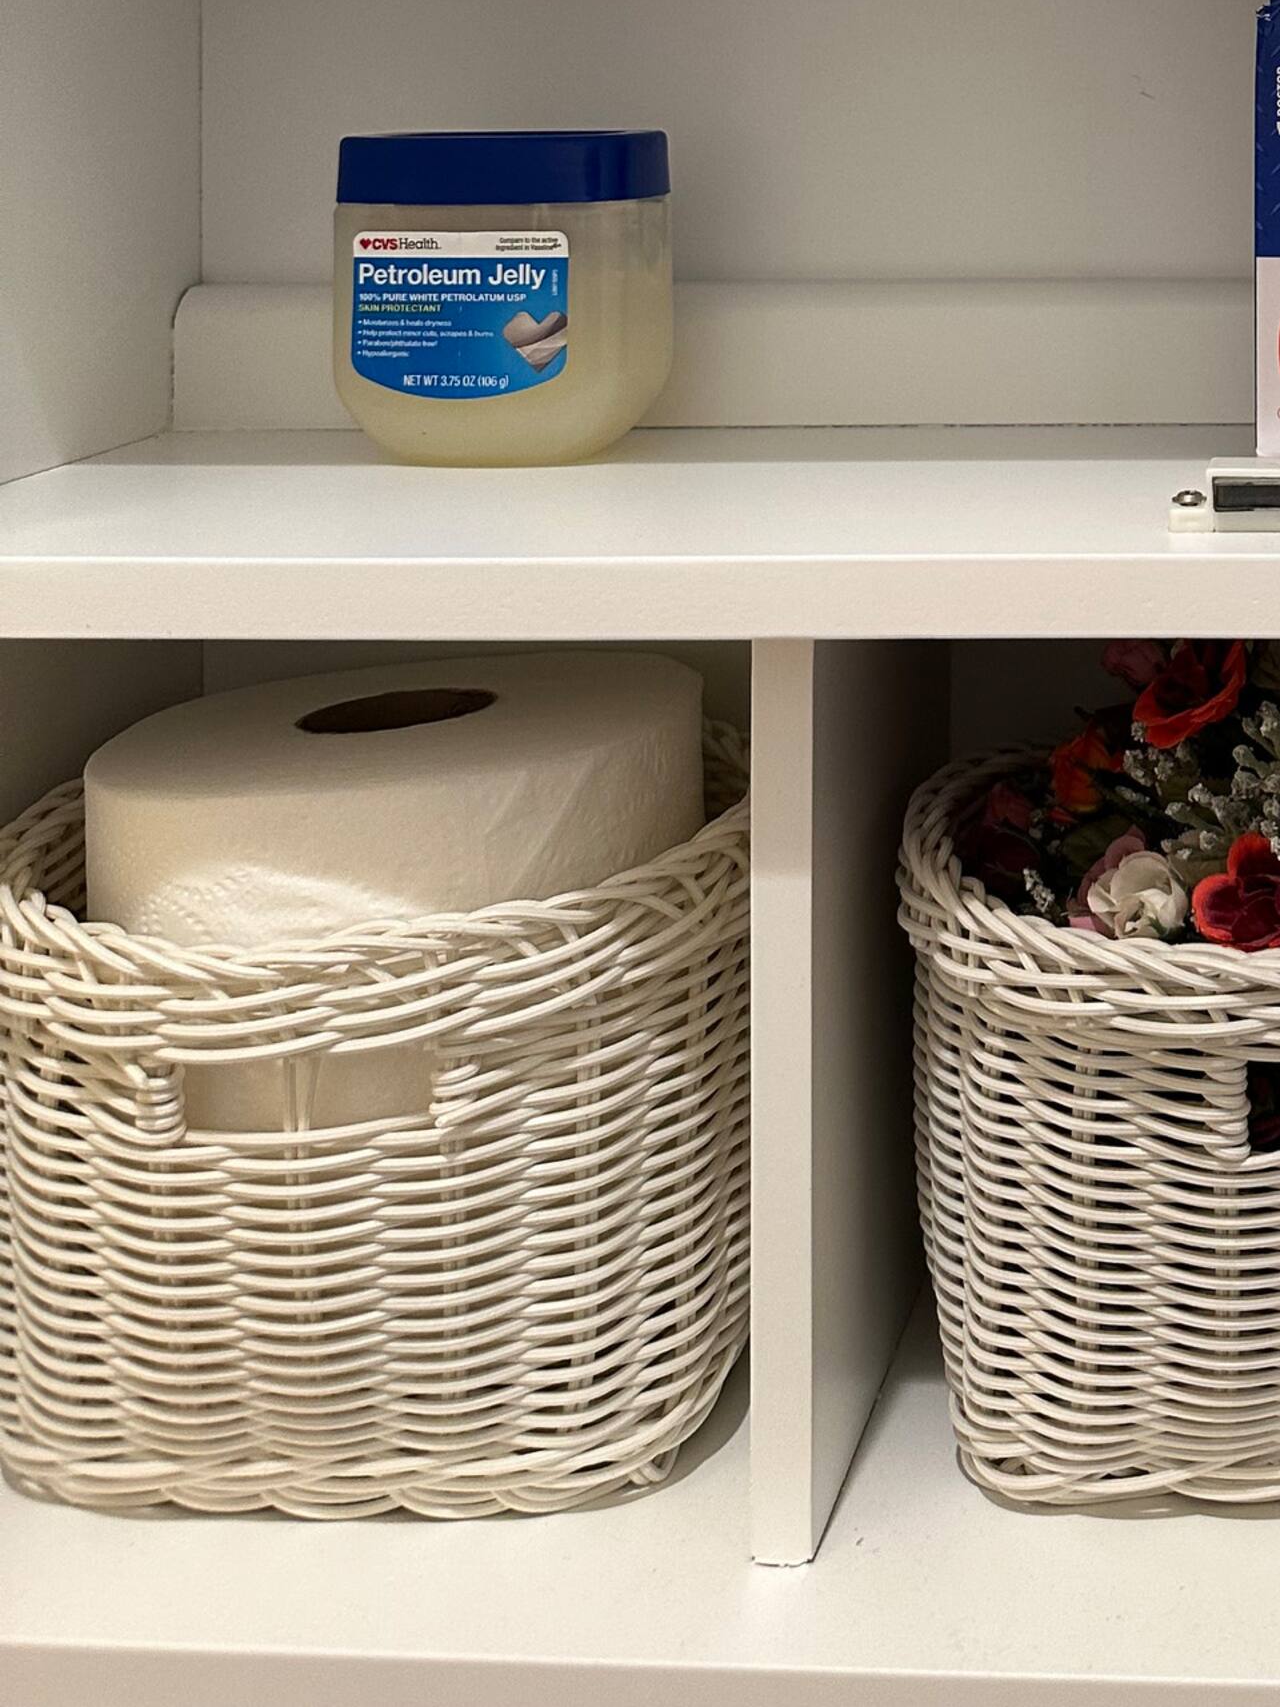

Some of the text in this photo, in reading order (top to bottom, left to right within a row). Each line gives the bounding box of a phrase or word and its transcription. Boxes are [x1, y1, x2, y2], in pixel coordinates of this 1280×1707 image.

[371, 237, 440, 251] CVS Health
[358, 263, 482, 285] Petroleum
[488, 263, 546, 290] Jelly
[403, 375, 509, 389] NET WT 3.75 OZ (106 g)
